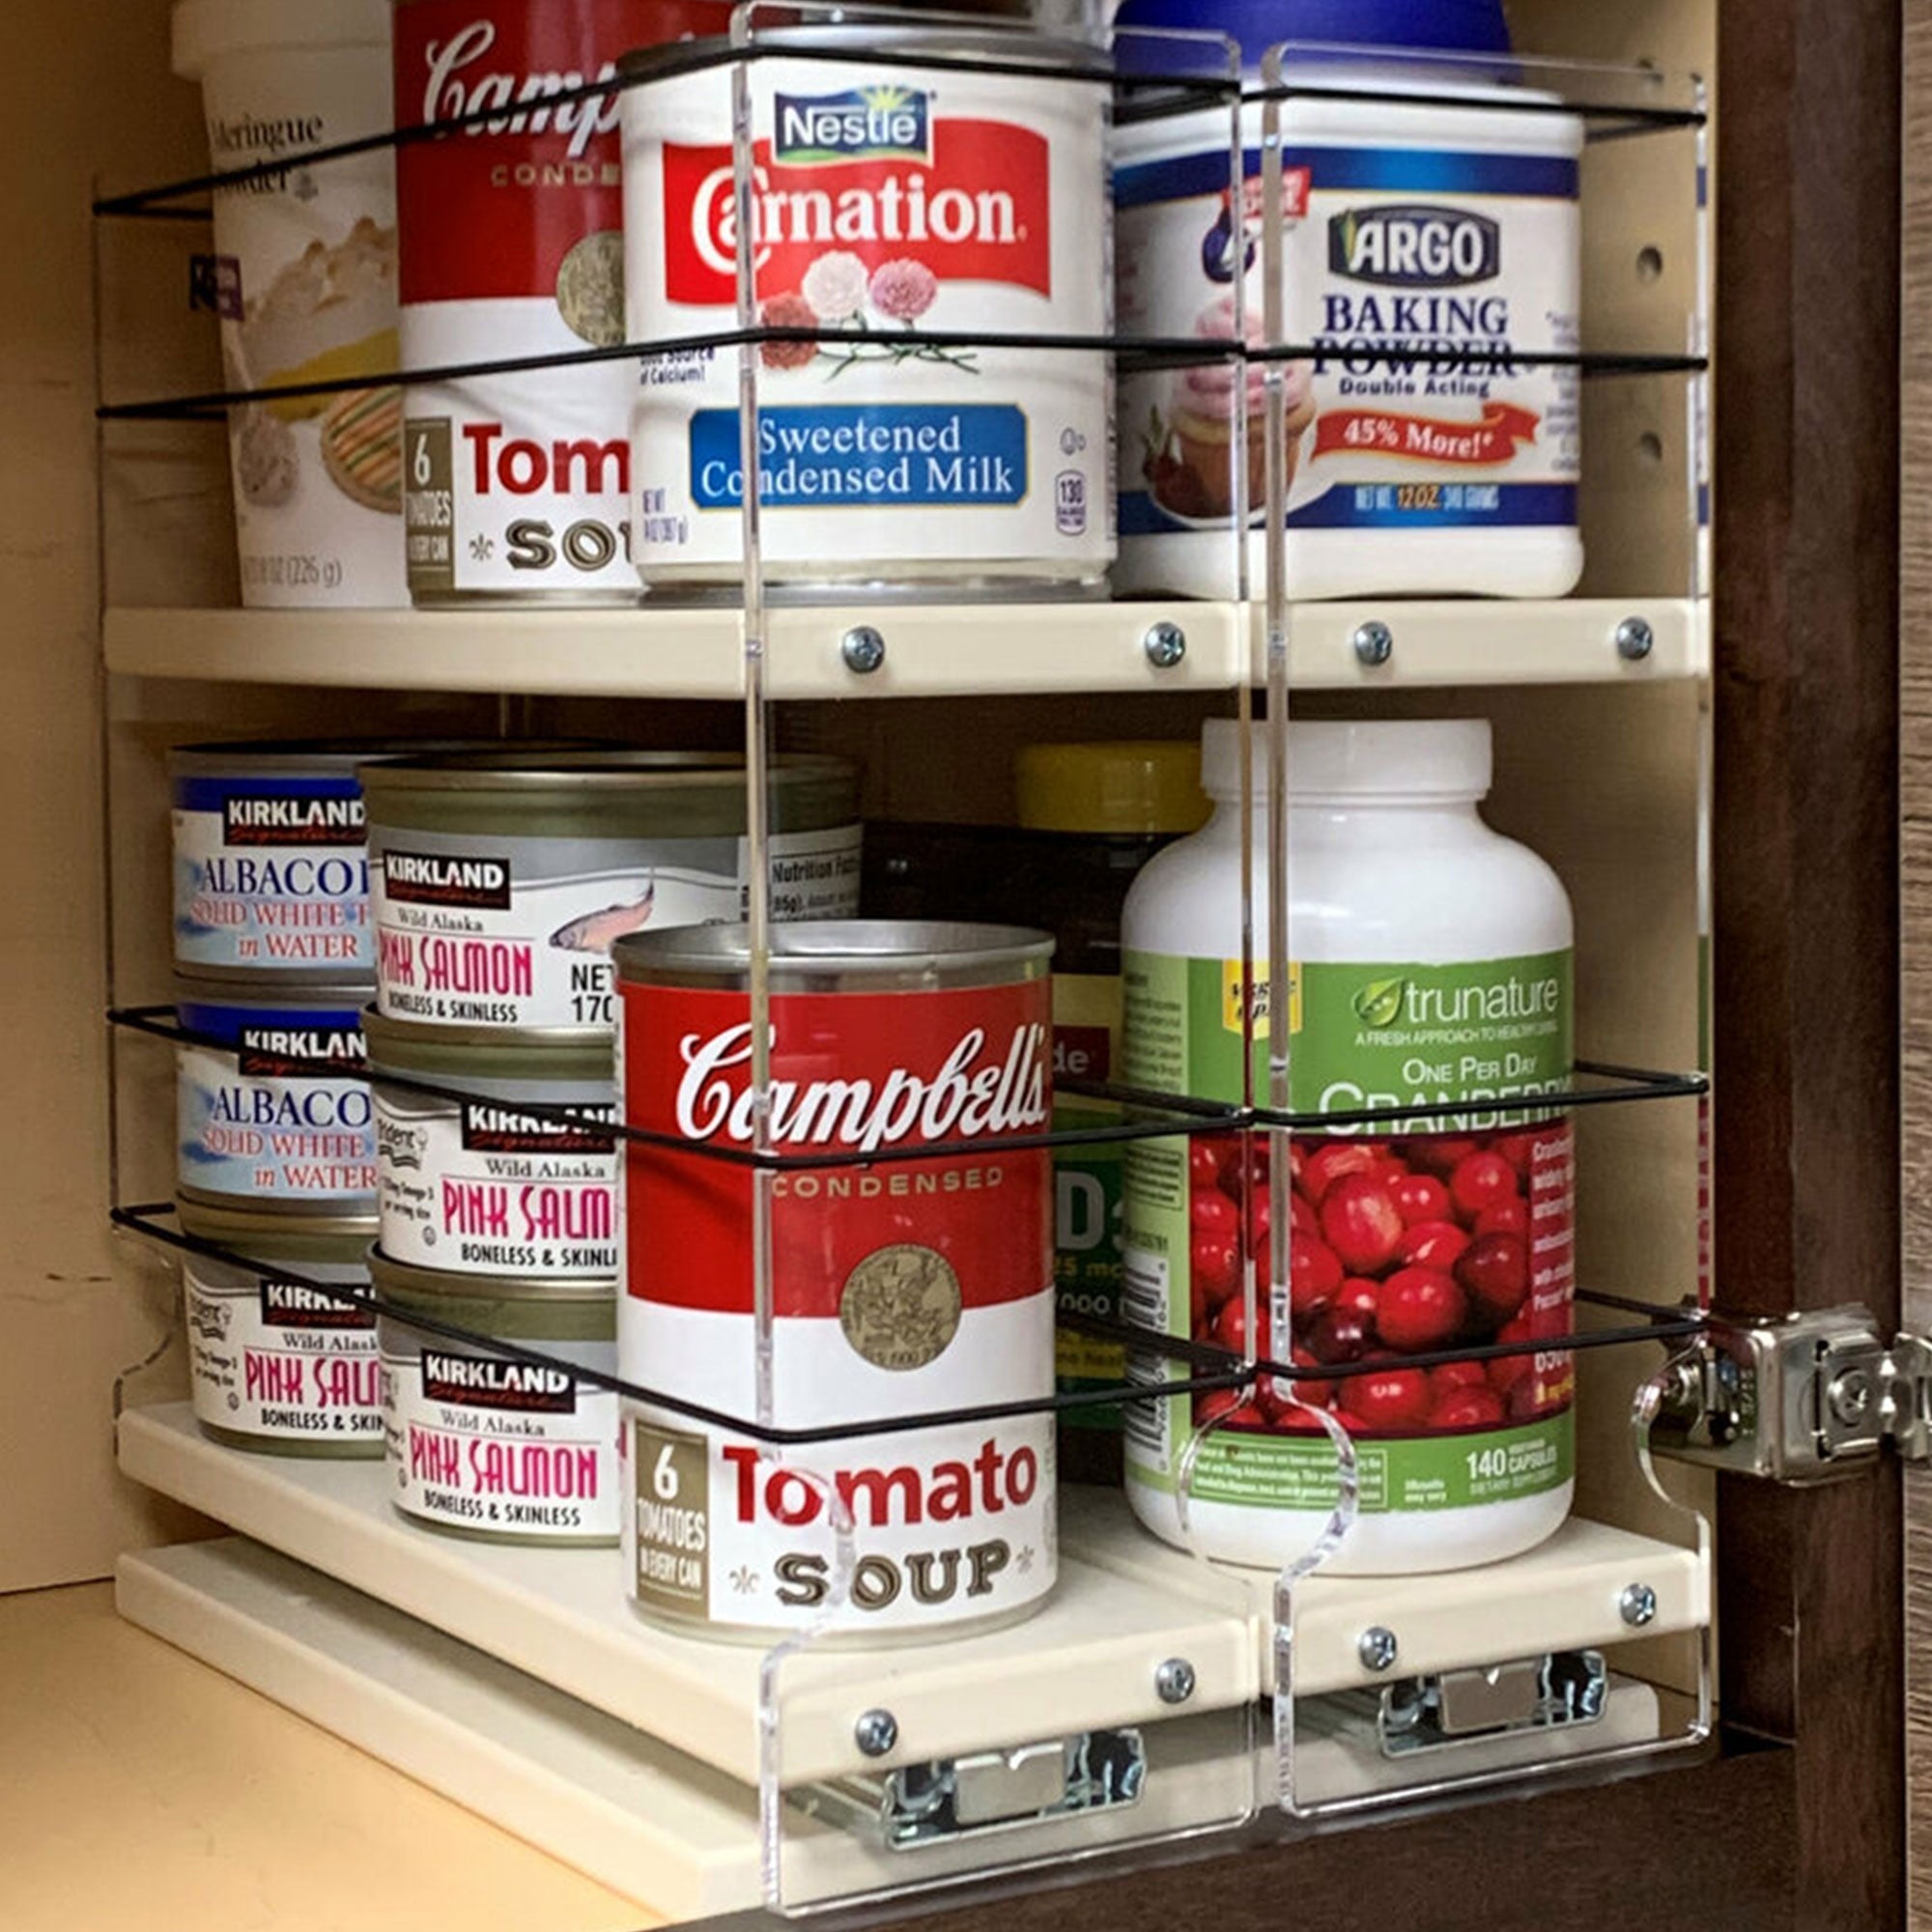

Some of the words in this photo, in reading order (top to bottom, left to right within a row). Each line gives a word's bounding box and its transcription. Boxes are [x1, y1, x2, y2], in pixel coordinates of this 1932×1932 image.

[692, 166, 1017, 274] Carnation
[1350, 220, 1484, 274] ARGO
[1322, 295, 1509, 336] BAKING
[1312, 336, 1517, 378] POWDER
[1339, 377, 1416, 395] Double
[1424, 378, 1491, 398] Acting
[759, 416, 961, 455] Sweetened
[1344, 418, 1400, 445] 45%
[414, 433, 431, 485] 6
[702, 459, 910, 497] Condensed
[926, 457, 1013, 494] Milk
[228, 800, 365, 827] KIRKLAND
[387, 854, 505, 890] KIRKLAND
[255, 903, 344, 926] WHITE
[434, 914, 485, 933] Alaska
[239, 937, 259, 955] in
[265, 935, 357, 957] WATER
[420, 936, 532, 997] SALMON
[451, 1001, 518, 1022] SKINLESS
[1406, 976, 1558, 1023] trunature
[677, 1021, 1047, 1168] Campbell's
[203, 1126, 264, 1154] SOLID
[271, 1132, 366, 1158] WHITE
[255, 1167, 275, 1187] in
[283, 1165, 378, 1189] WATER
[487, 1158, 531, 1178] Wild
[538, 1161, 606, 1178] Alaska
[775, 1167, 1004, 1198] CONDENSED
[442, 1179, 509, 1237] PINK
[461, 1243, 536, 1265] BONELESS
[542, 1249, 554, 1265] &
[283, 1332, 325, 1350] Wild
[245, 1351, 303, 1405] PINK
[426, 1355, 570, 1394] KIRKLAND
[261, 1408, 328, 1430] BONELESS
[333, 1414, 345, 1431] &
[440, 1408, 479, 1431] Wild
[484, 1417, 546, 1436] Alaska
[410, 1426, 460, 1489] PINK
[469, 1439, 597, 1500] SALMON
[653, 1444, 679, 1500] 6
[1466, 1448, 1506, 1480] 140
[723, 1438, 1037, 1528] Tomato
[424, 1489, 483, 1520] BONELESS
[489, 1503, 499, 1520] &
[505, 1503, 582, 1526] SKINLESS
[638, 1497, 706, 1552] TOMATOES
[678, 1556, 701, 1589] CAN
[774, 1539, 1010, 1611] SOUP
